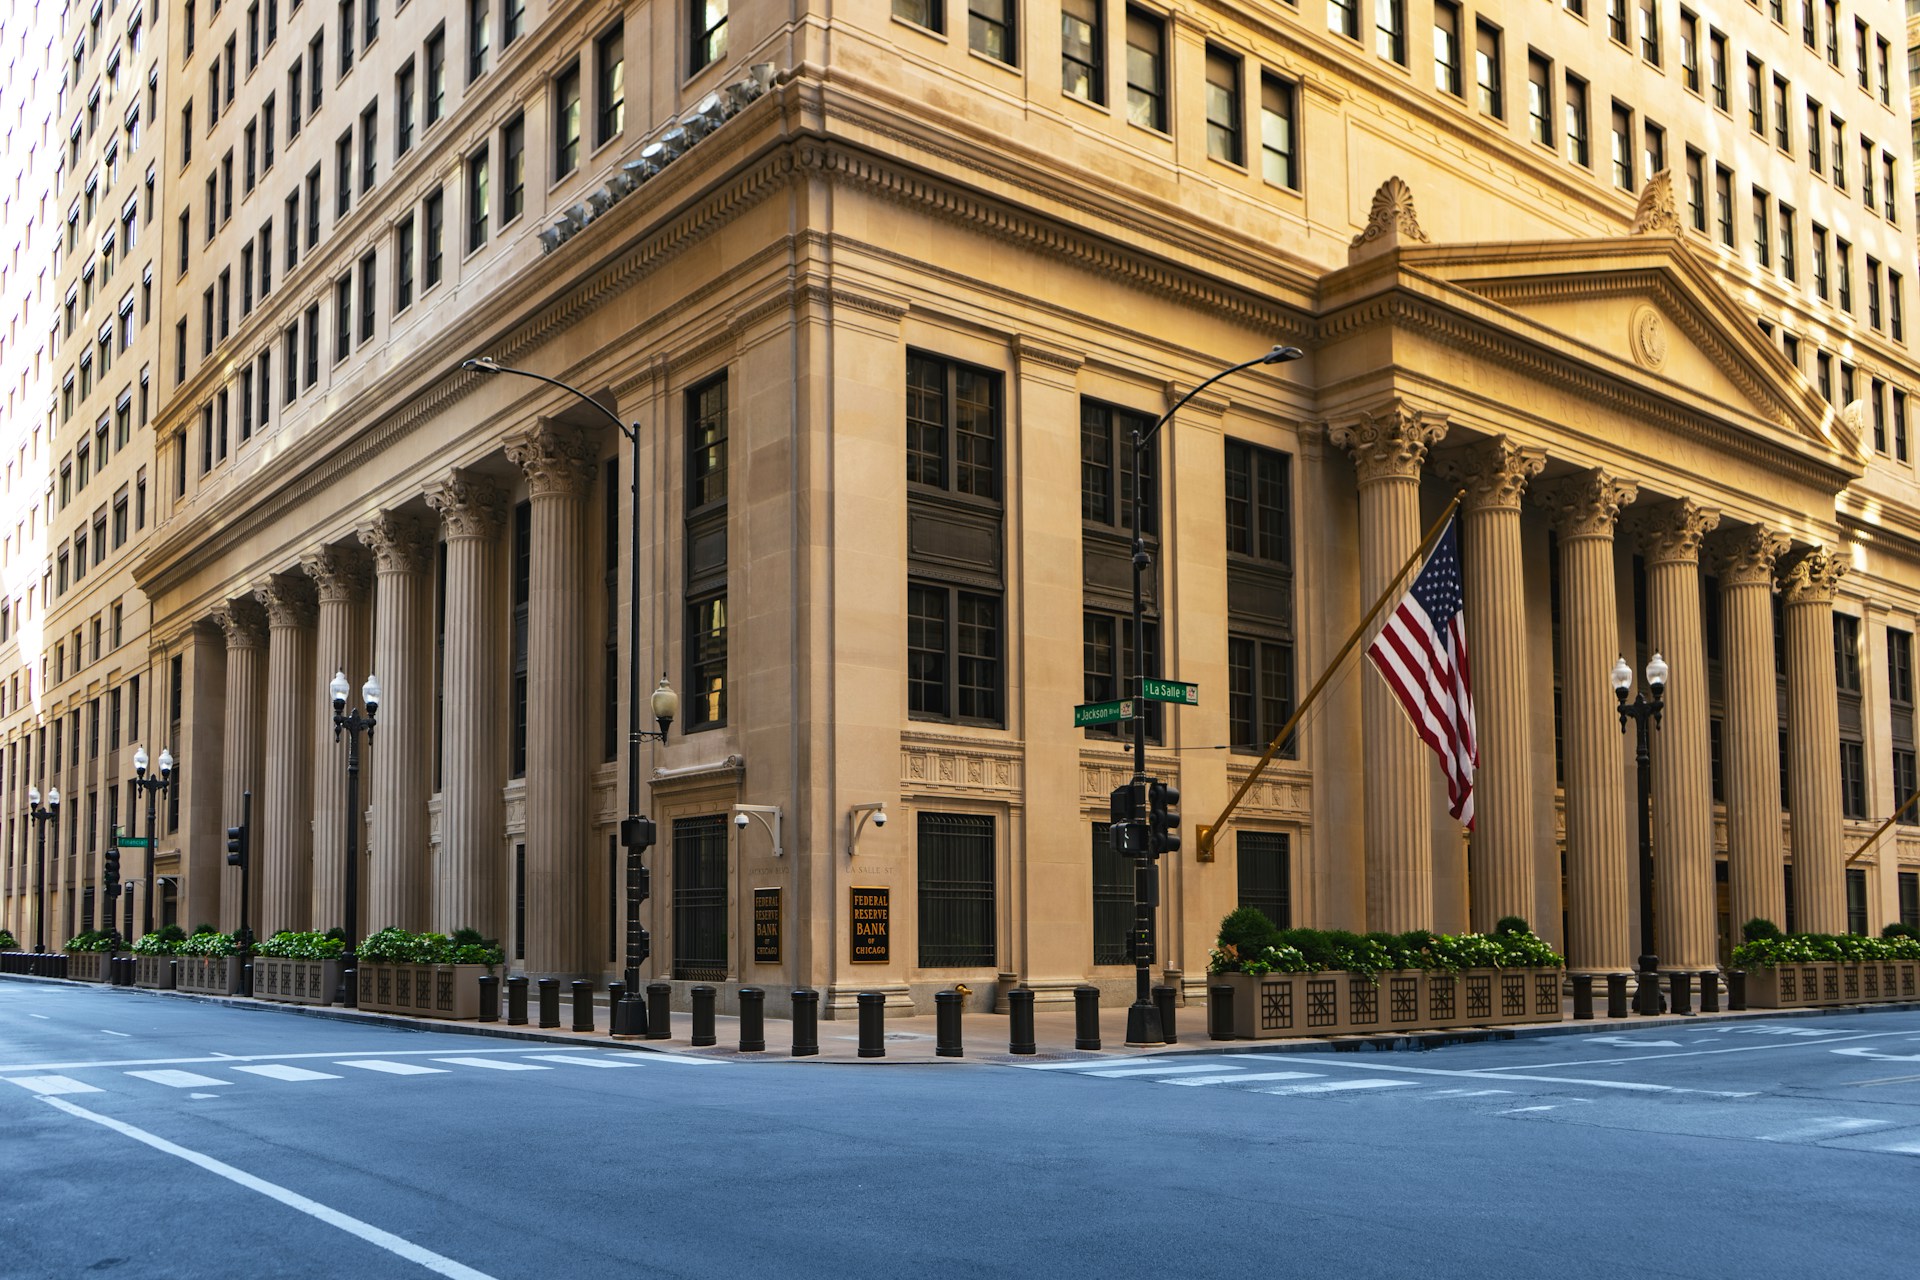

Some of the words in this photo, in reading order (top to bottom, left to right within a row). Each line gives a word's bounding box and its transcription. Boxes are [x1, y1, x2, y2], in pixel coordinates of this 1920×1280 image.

[1448, 353, 1543, 410] FEDERAL
[1558, 396, 1642, 446] RESERVE
[1656, 433, 1699, 467] BANK
[1709, 453, 1729, 478] OF
[1737, 465, 1807, 507] CHICAGO
[1149, 683, 1160, 696] La
[1161, 684, 1181, 698] Salle
[1081, 708, 1108, 721] Jackson
[845, 866, 855, 874] LA
[858, 866, 880, 874] SALLE
[755, 896, 779, 907] FEDERAL
[854, 895, 888, 906] FEDERAL
[755, 909, 779, 921] RESERVE
[854, 909, 888, 920] RESERVE
[756, 923, 778, 936] BANK
[856, 922, 886, 936] BANK
[756, 946, 778, 955] CHICAGO
[855, 946, 886, 955] CHICAGO
